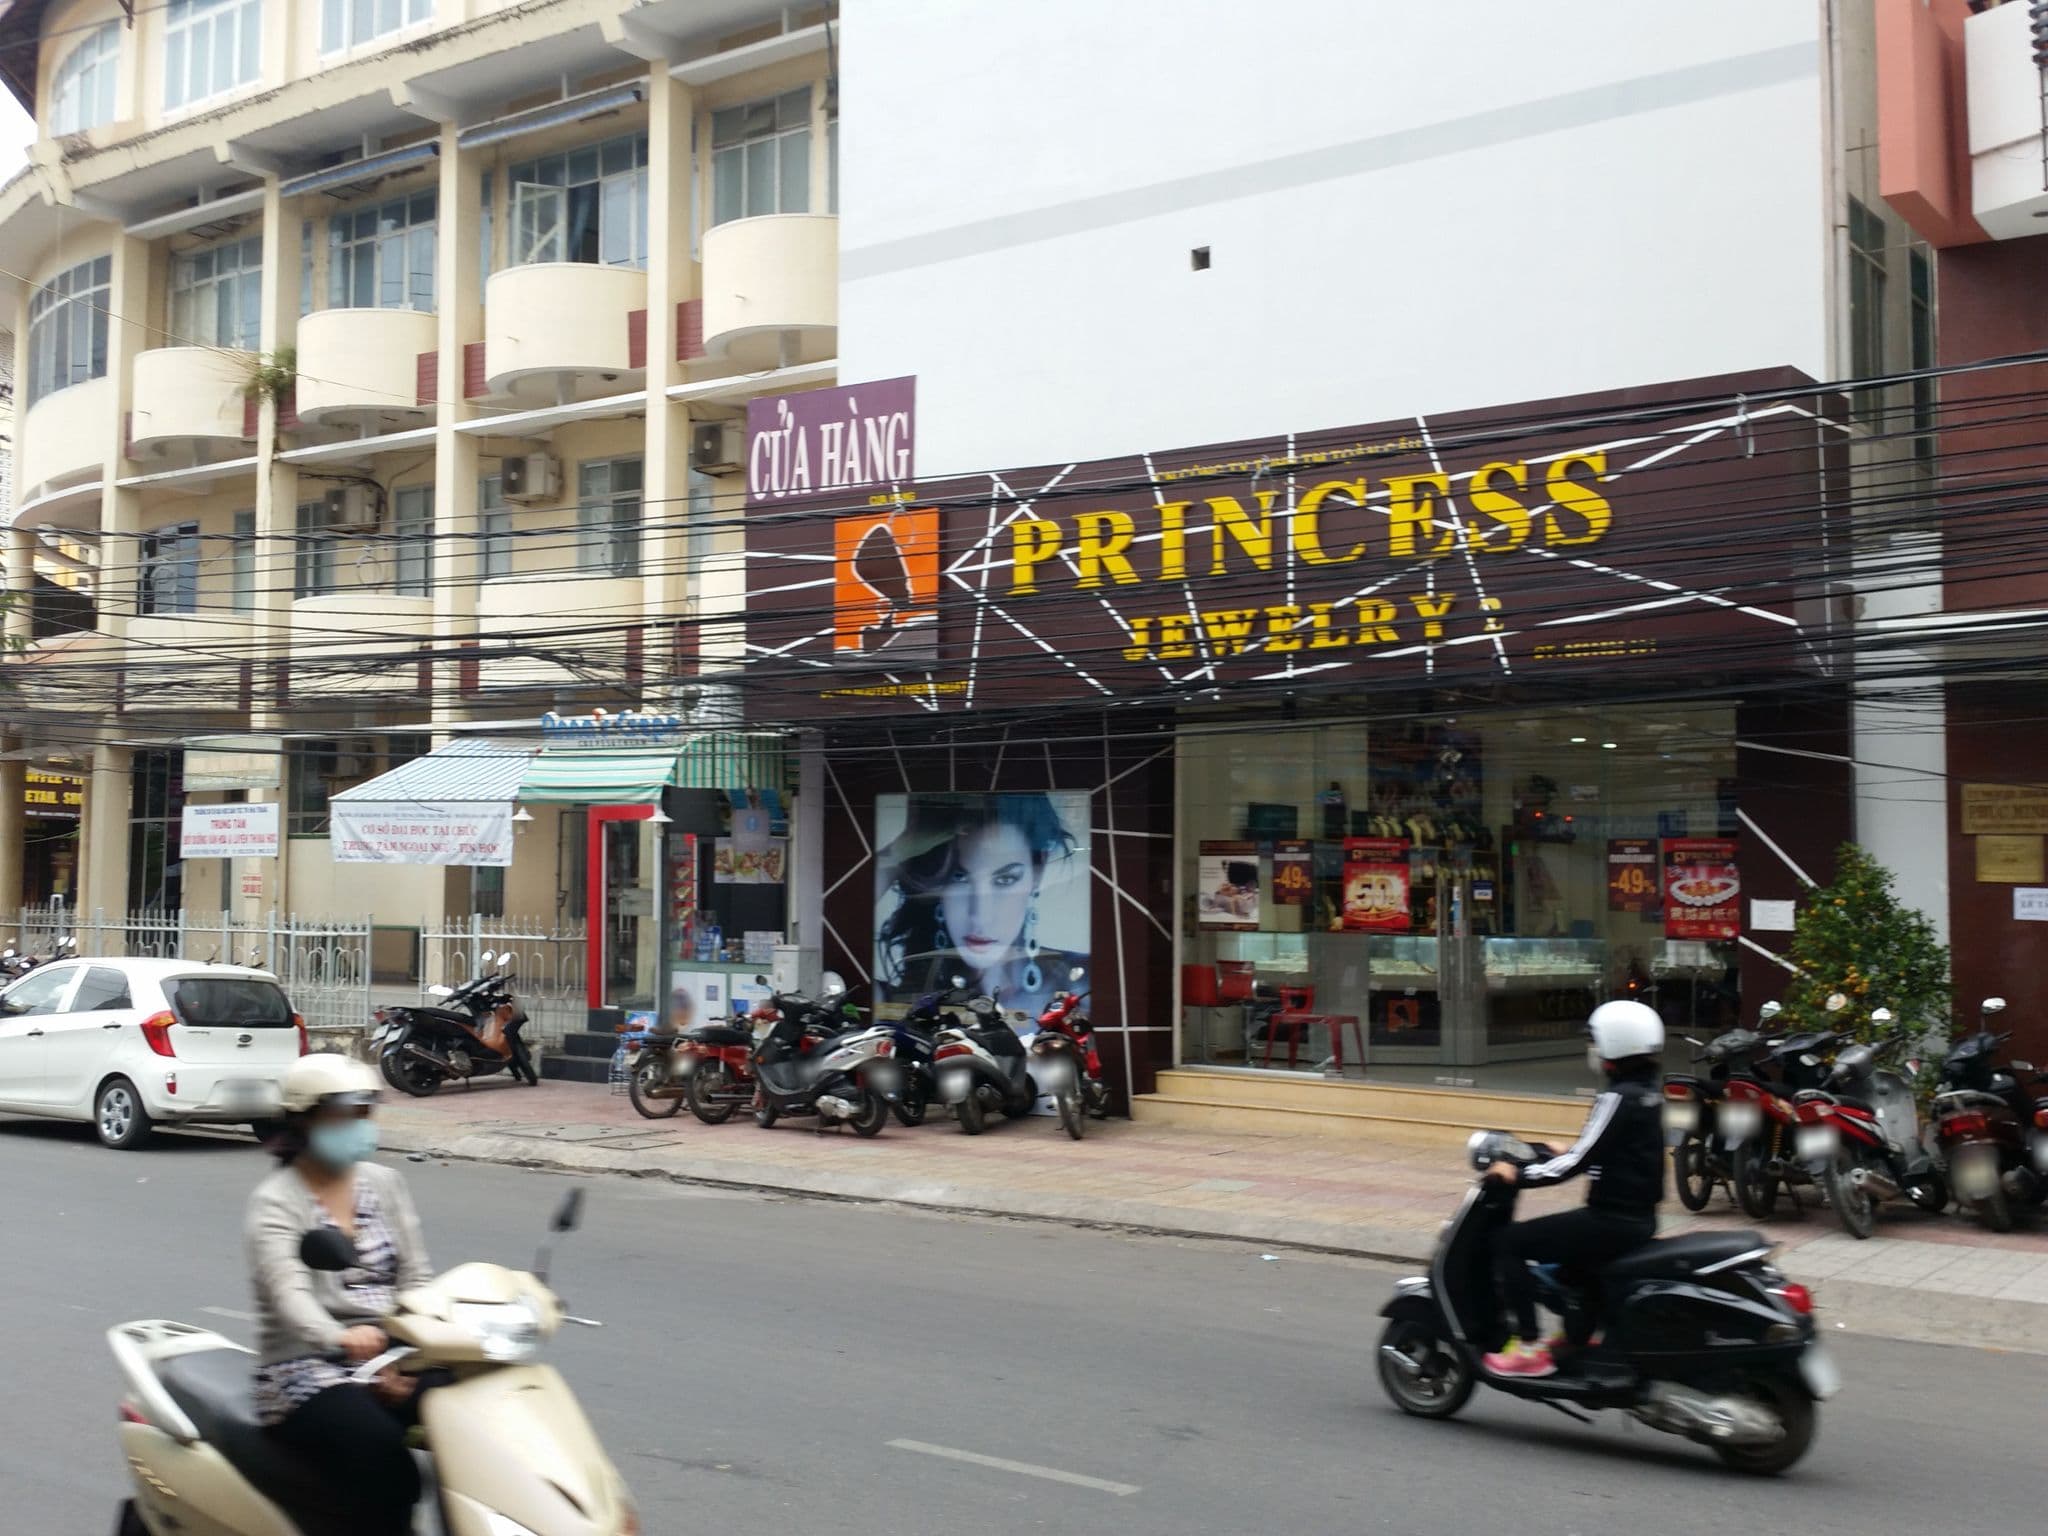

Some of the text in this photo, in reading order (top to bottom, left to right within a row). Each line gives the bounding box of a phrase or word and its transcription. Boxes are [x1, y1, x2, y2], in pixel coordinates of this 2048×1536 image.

[751, 396, 911, 501] CỬA HÀNG
[1007, 449, 1614, 596] PRINCESS
[1122, 592, 1457, 662] JEWELRY
[24, 789, 59, 805] ETAIL
